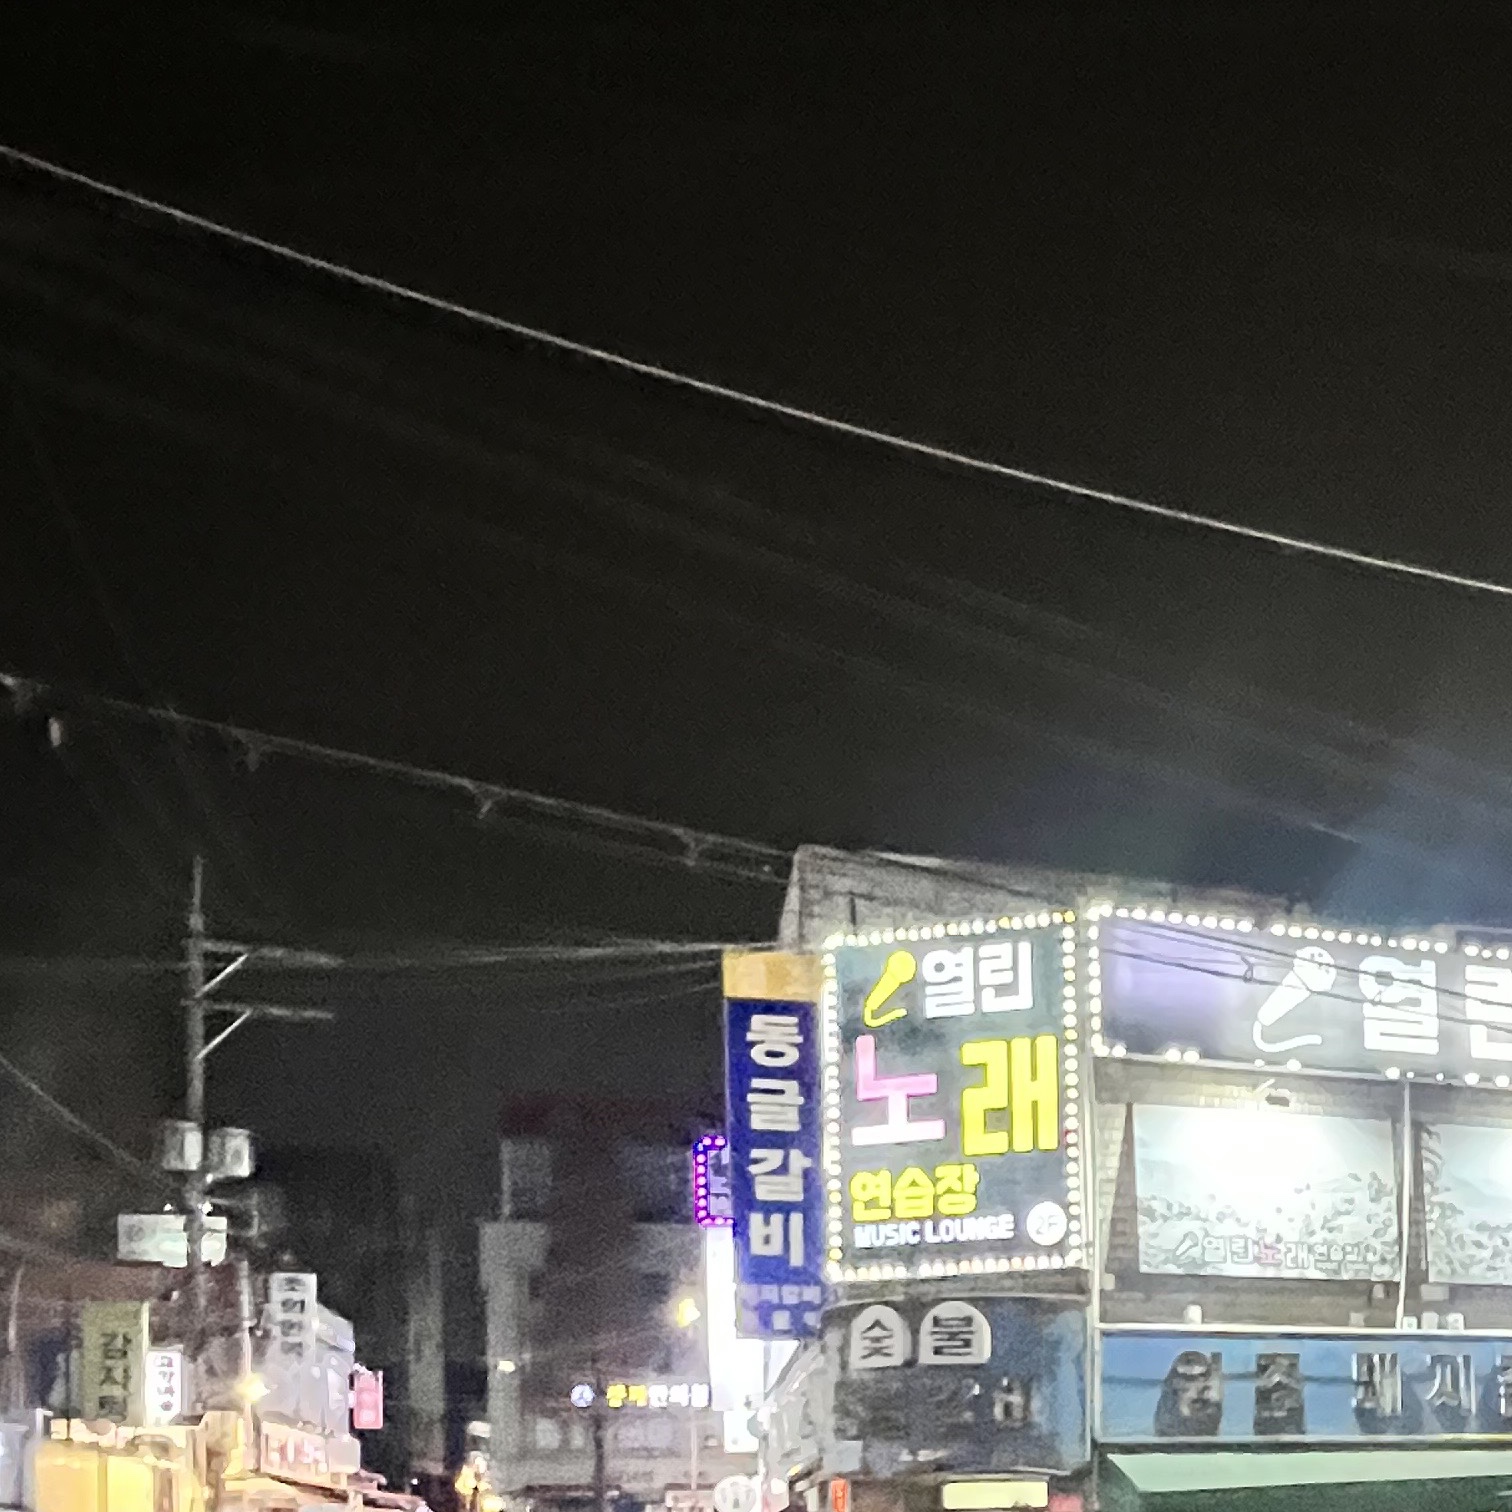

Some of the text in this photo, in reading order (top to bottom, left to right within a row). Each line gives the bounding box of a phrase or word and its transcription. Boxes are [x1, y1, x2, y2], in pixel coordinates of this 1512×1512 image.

[922, 940, 1034, 1018] 열린
[851, 1034, 1059, 1157] 노래
[850, 1163, 980, 1221] 연습장
[854, 1213, 1015, 1248] MUSIC LOUNGE
[860, 1316, 977, 1360] 숯불
